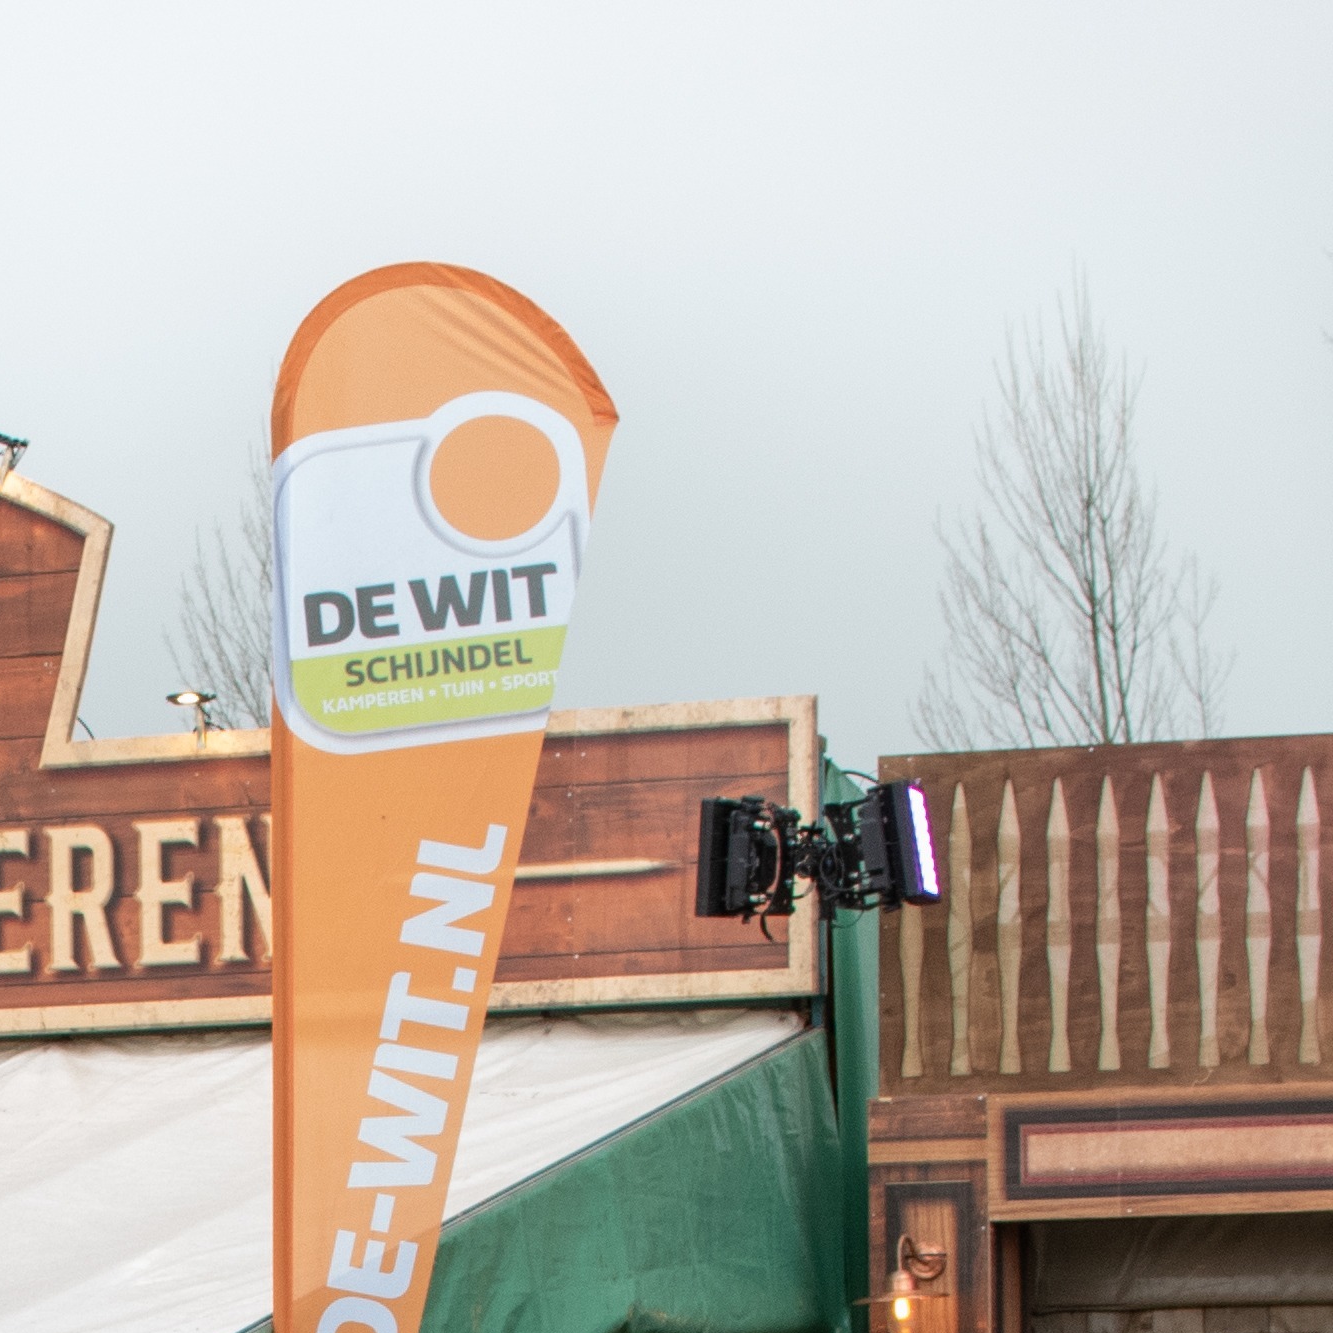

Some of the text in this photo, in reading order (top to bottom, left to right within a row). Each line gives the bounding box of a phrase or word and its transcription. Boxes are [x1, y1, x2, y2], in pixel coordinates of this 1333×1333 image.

[303, 562, 558, 647] DE WIT
[345, 639, 533, 687] SCHIJNDEL
[321, 669, 559, 714] KAMPEREN TUIN SPORT
